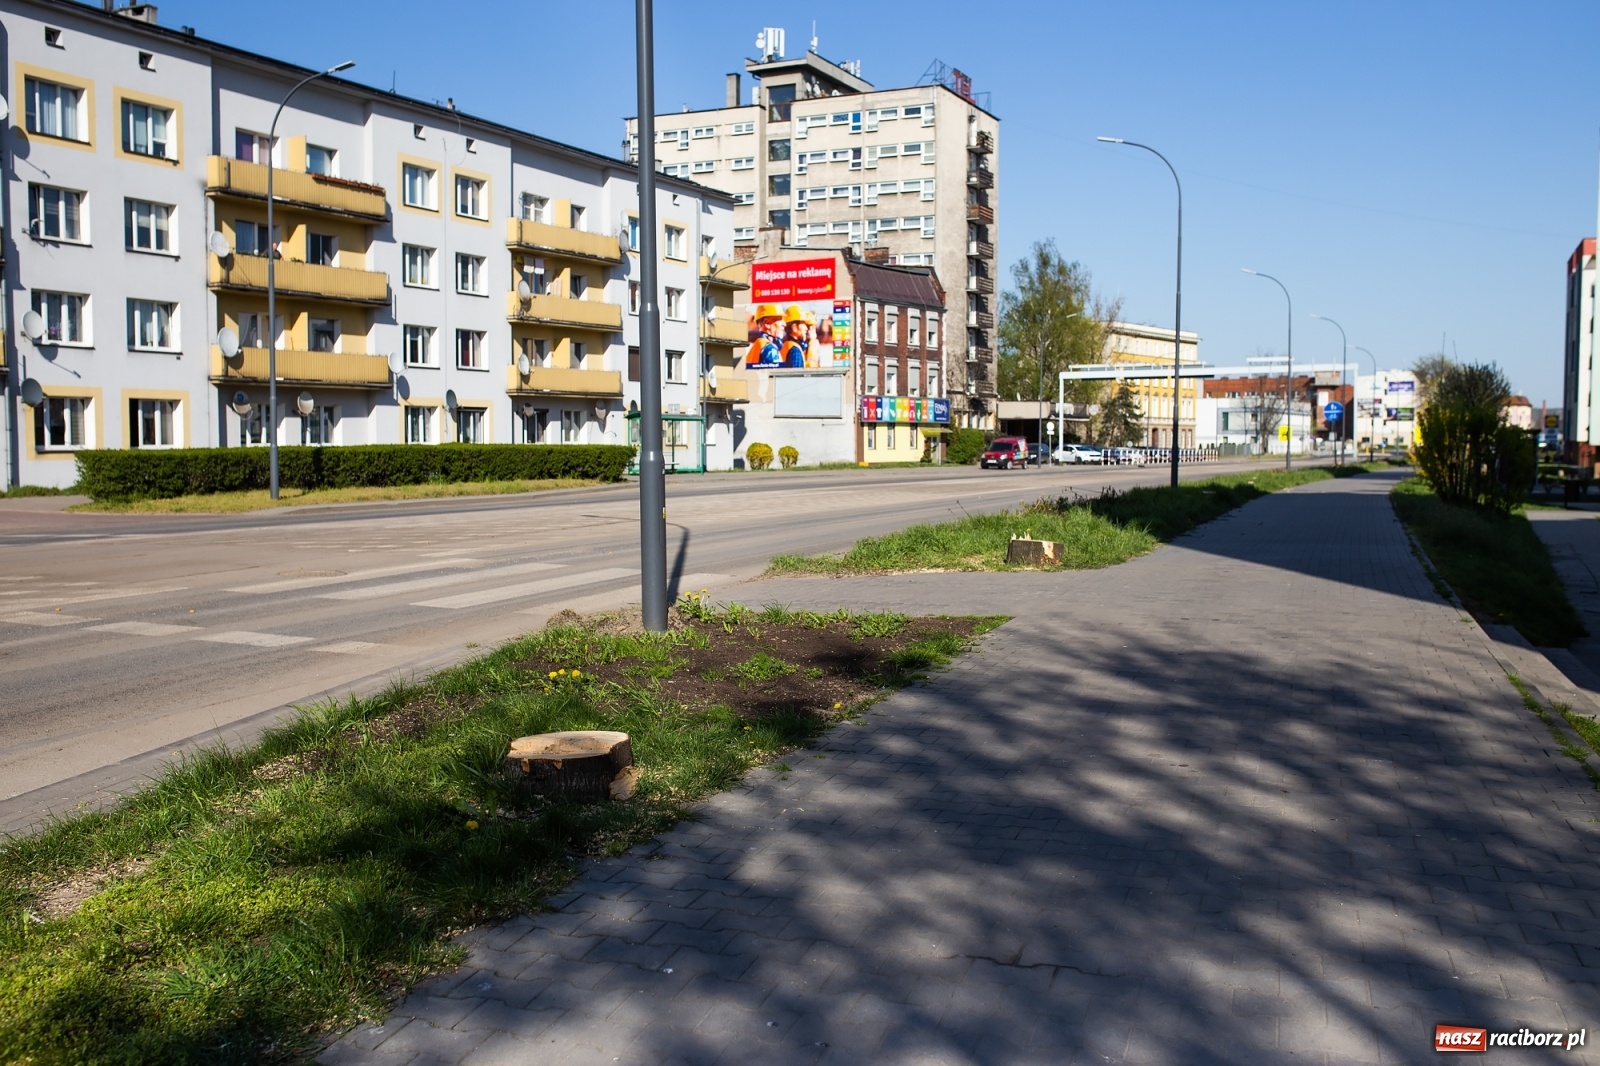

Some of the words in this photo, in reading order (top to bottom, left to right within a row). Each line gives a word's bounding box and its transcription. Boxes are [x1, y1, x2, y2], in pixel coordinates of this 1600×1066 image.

[756, 270, 786, 282] Miejsce
[787, 270, 797, 278] na
[798, 267, 832, 278] reklamę
